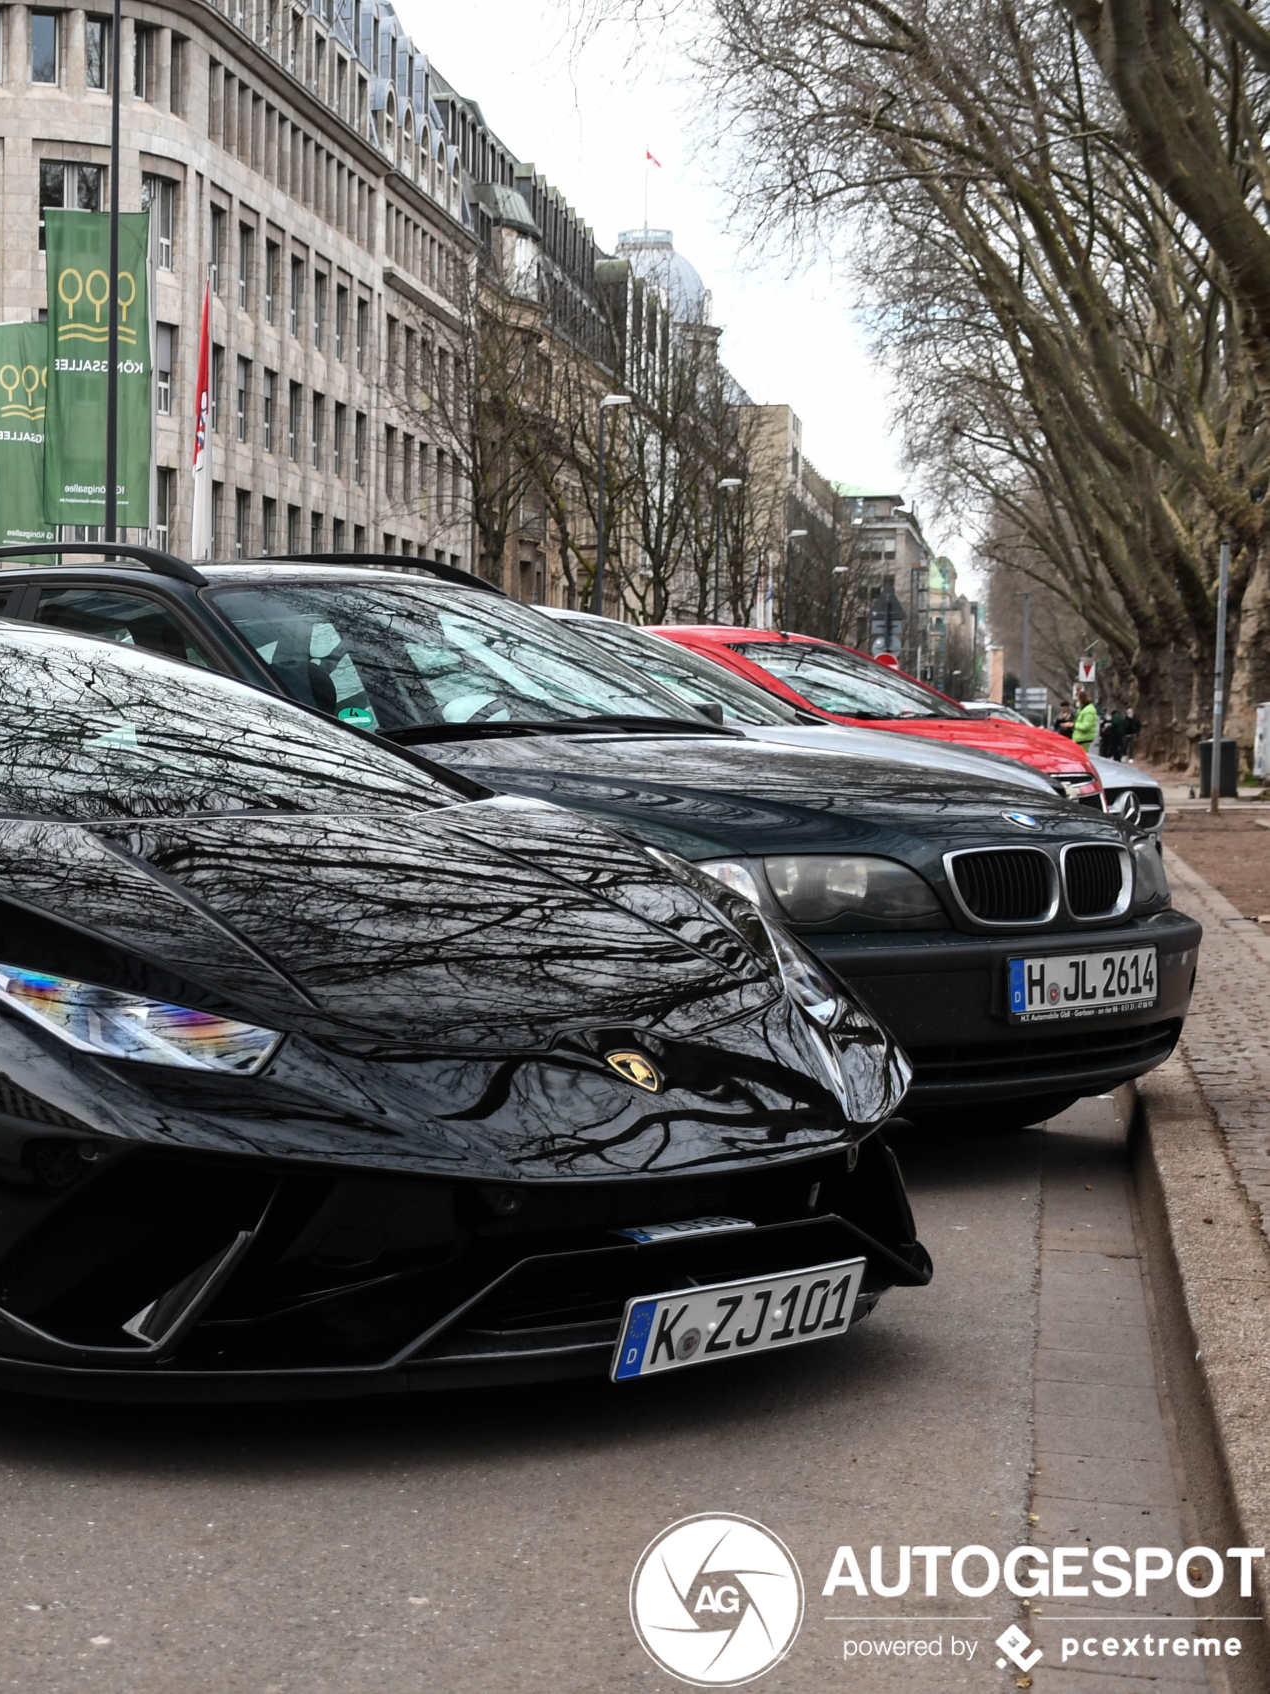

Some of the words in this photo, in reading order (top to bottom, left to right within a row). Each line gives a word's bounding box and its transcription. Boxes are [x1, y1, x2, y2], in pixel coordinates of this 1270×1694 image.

[1027, 963, 1045, 1005] H
[1064, 959, 1096, 1001] JL
[1102, 953, 1154, 998] 2614
[1014, 990, 1021, 1003] D
[649, 1304, 689, 1365] K
[626, 1348, 637, 1364] D
